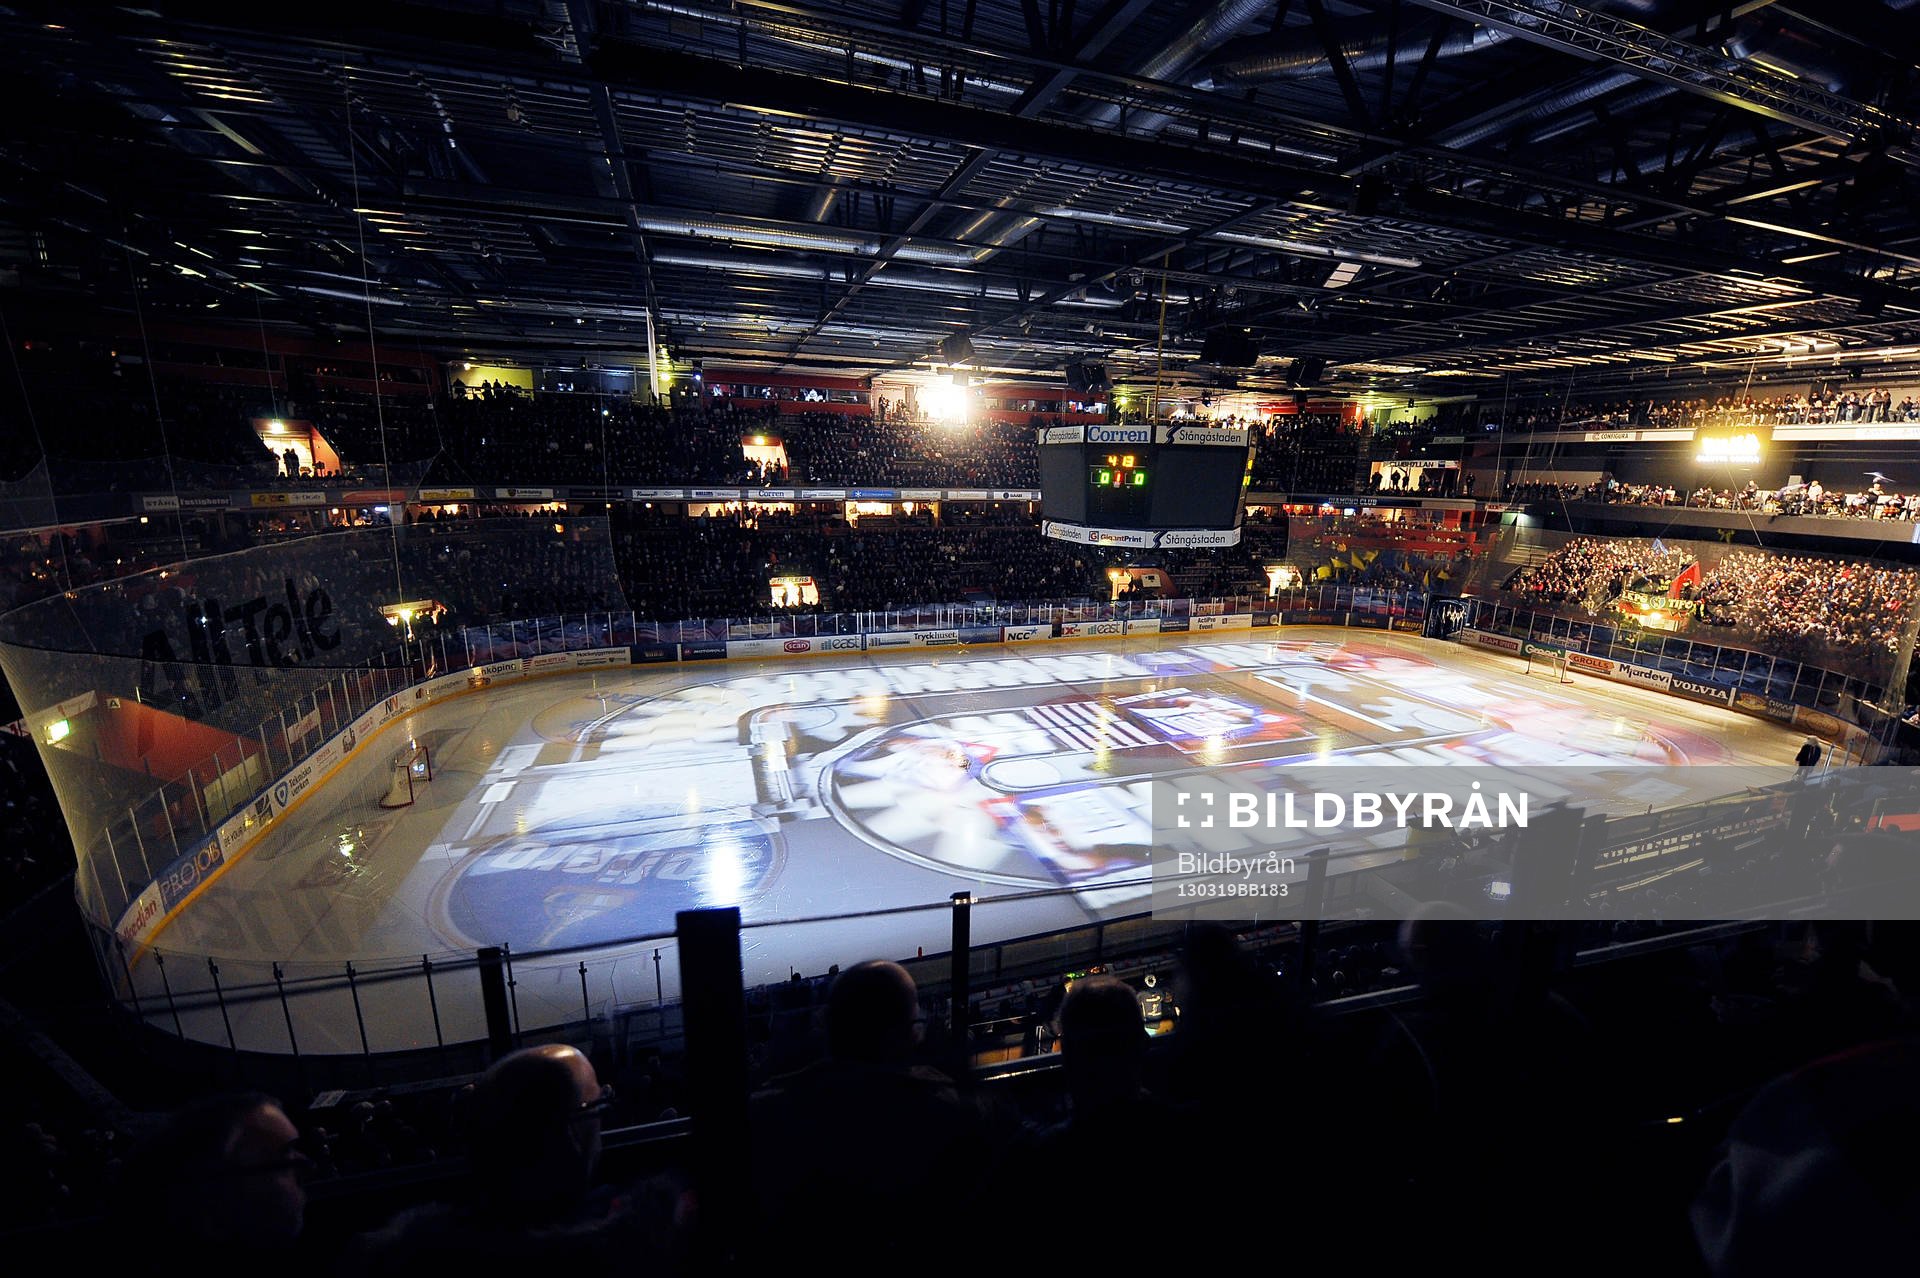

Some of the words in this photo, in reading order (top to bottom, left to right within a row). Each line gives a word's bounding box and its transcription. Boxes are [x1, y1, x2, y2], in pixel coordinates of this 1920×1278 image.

[1088, 427, 1149, 442] Corren
[1179, 429, 1241, 445] Stångåstaden
[1100, 472, 1110, 484] 0
[1134, 473, 1144, 485] 0
[758, 489, 785, 498] Corren
[1359, 498, 1378, 506] CLUB
[1166, 533, 1226, 548] Stångåstaden
[1097, 623, 1121, 634] east
[1008, 632, 1031, 641] NCC
[832, 636, 860, 650] east
[1574, 656, 1609, 669] GROLLS
[1673, 679, 1728, 700] VOLVIA
